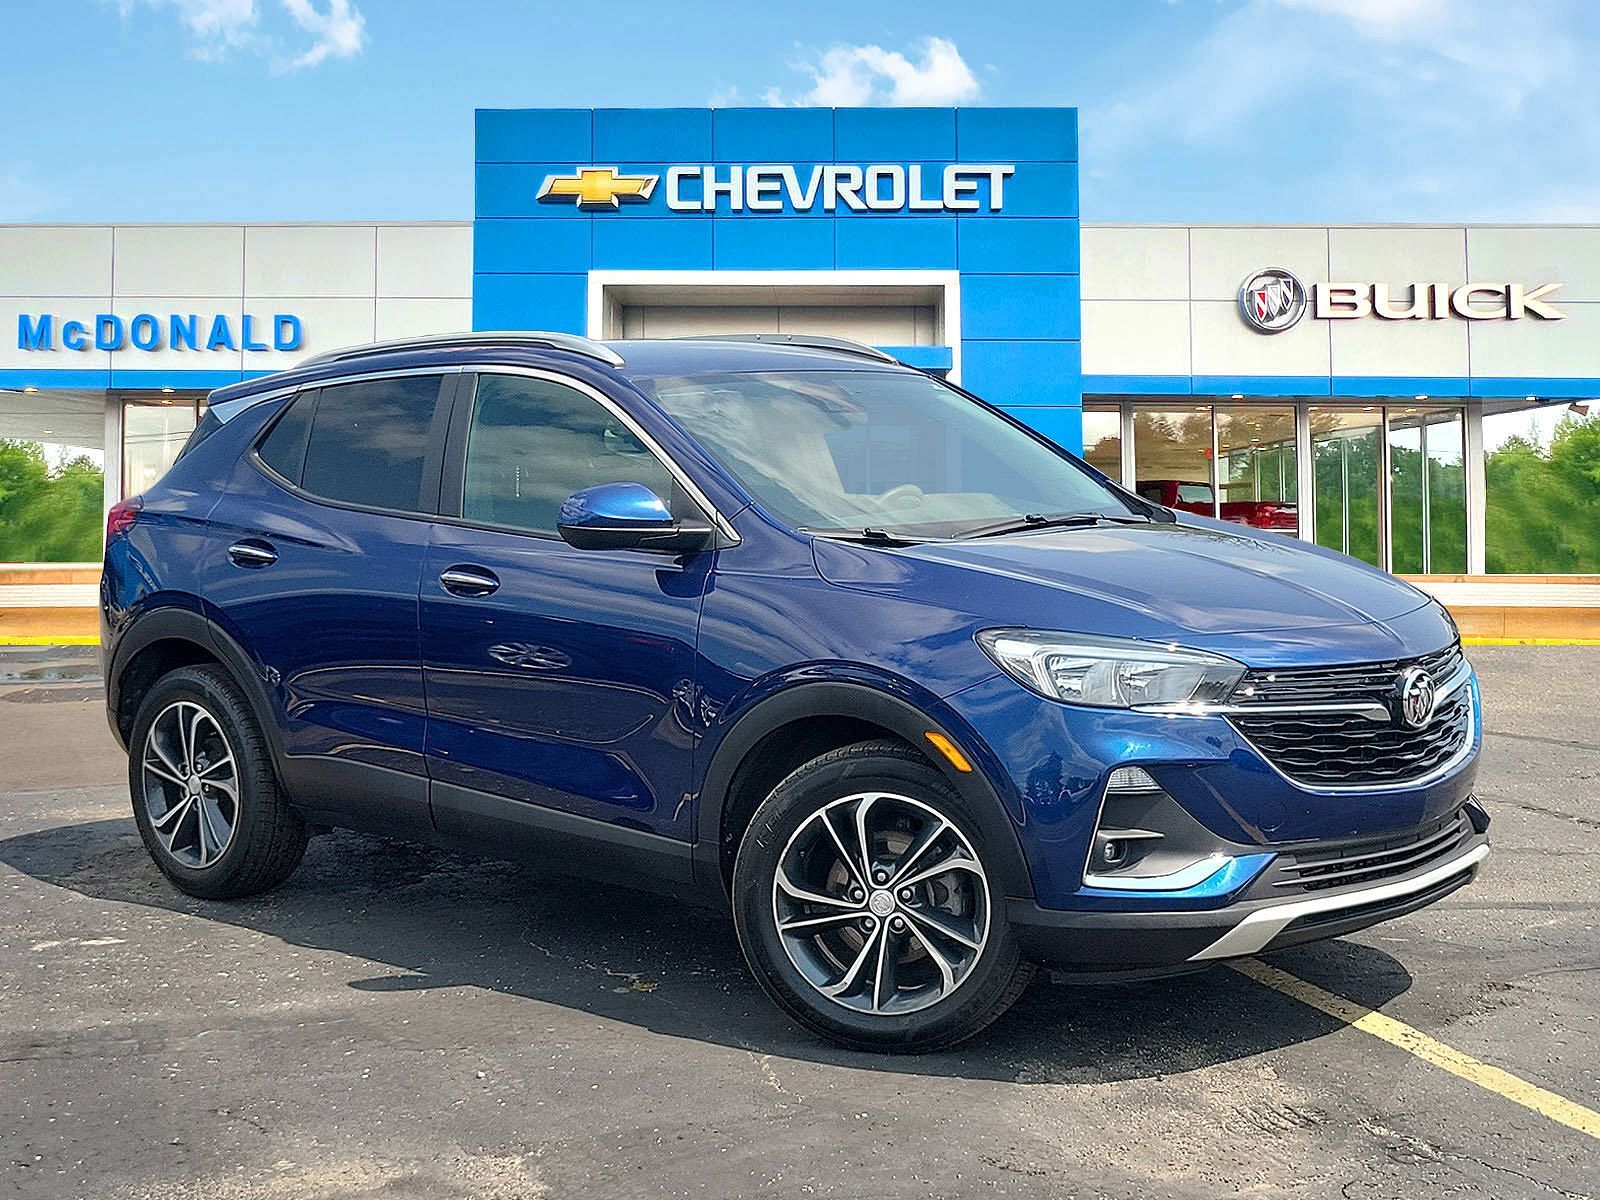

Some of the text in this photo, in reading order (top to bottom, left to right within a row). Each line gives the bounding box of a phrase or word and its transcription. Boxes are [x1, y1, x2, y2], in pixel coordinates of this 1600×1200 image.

[666, 165, 1015, 210] CHEVROLET
[1315, 282, 1565, 320] BUICK
[18, 314, 303, 350] McDONALD
